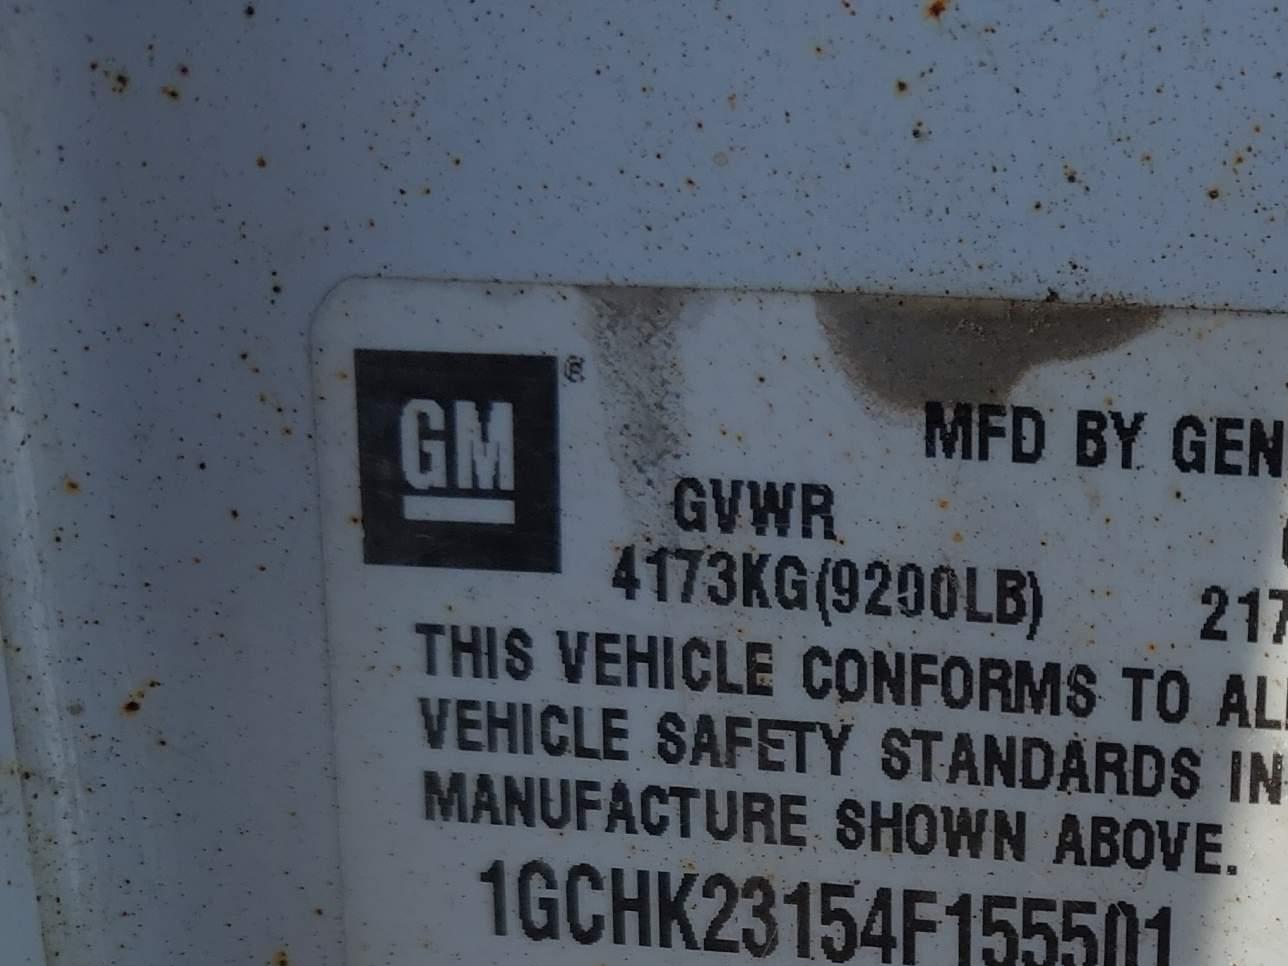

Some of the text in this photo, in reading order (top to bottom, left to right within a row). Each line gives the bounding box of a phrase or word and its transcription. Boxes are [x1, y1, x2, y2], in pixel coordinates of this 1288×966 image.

[400, 399, 514, 491] GM
[925, 400, 1046, 464] MFD
[1076, 409, 1148, 469] BY
[673, 476, 836, 540] GVWR
[611, 546, 1044, 639] 4173KG(9200LB)
[416, 624, 534, 681] THIS
[556, 630, 774, 696] VEHICLE
[802, 643, 1097, 718] CONFORMS
[1122, 667, 1190, 724] TO
[421, 698, 629, 760] VEHICLE
[656, 711, 852, 776] SAFETY
[880, 727, 1200, 800] STANDARDS
[1230, 750, 1284, 805] IN
[424, 771, 1238, 875] MANUFACTURE SHOWN ABOVE.
